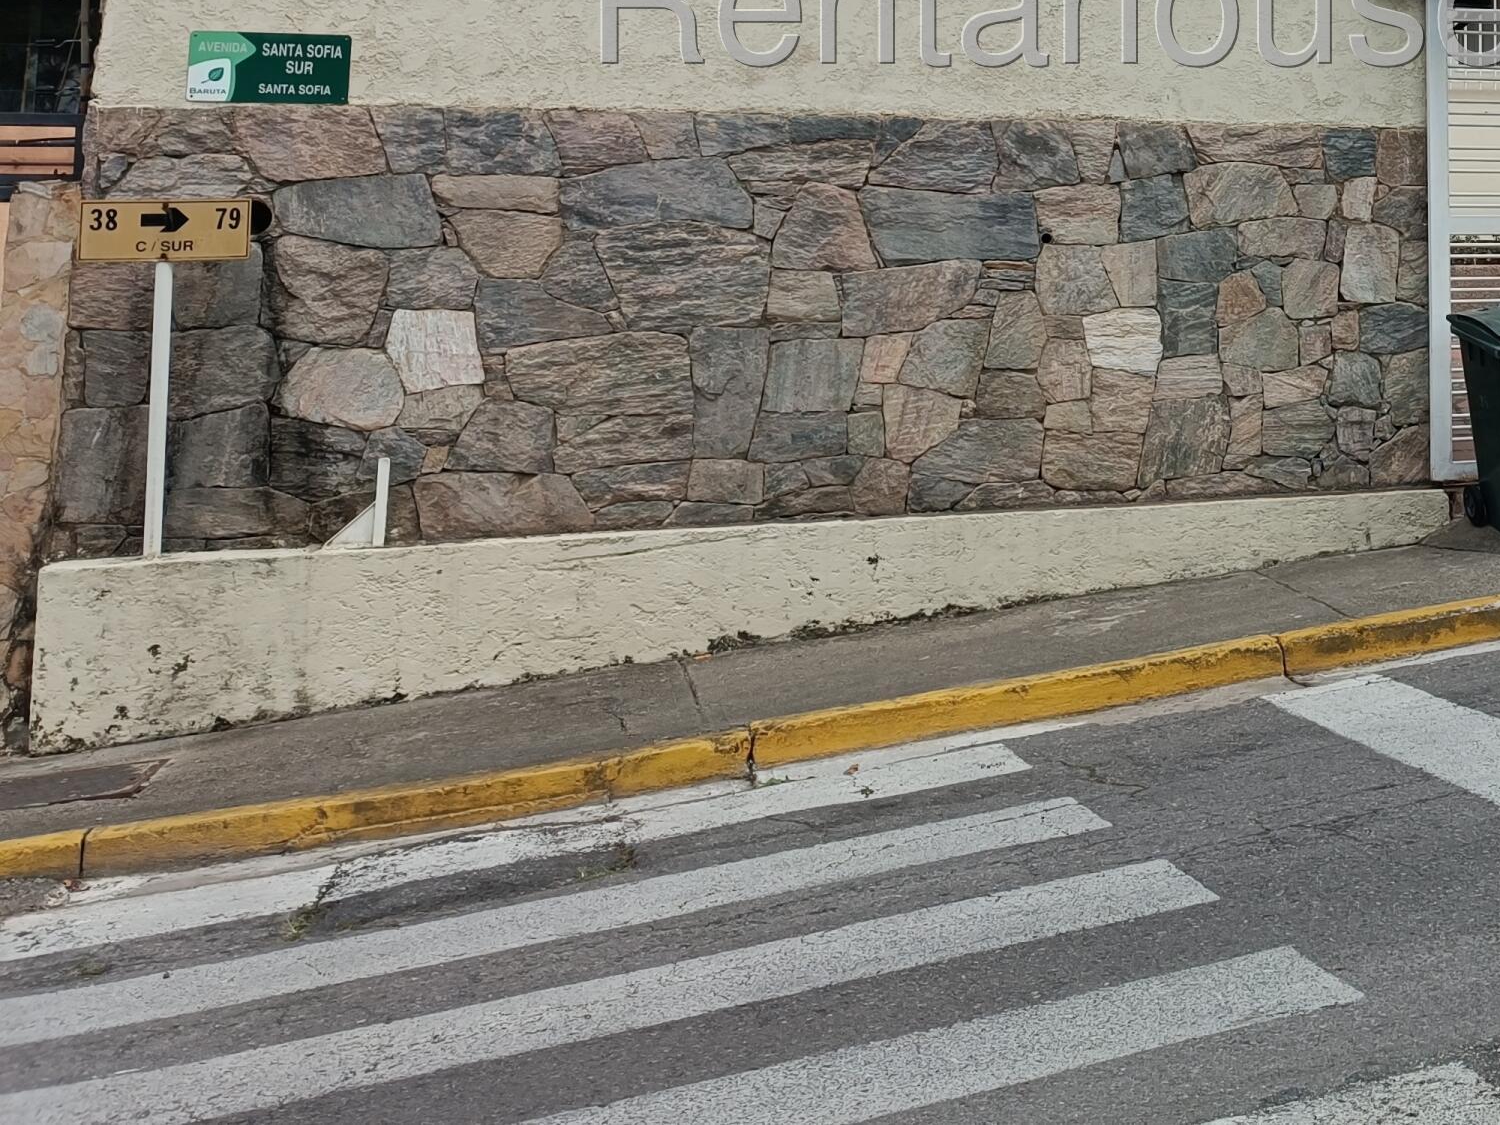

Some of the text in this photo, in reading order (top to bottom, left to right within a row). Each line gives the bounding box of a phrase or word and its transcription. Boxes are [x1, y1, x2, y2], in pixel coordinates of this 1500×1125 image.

[198, 41, 247, 53] AVENIDA
[262, 42, 342, 59] SANTA SOFIA
[285, 61, 313, 75] SUR
[258, 83, 331, 95] SANTA SOFIA
[89, 207, 241, 231] 38 79
